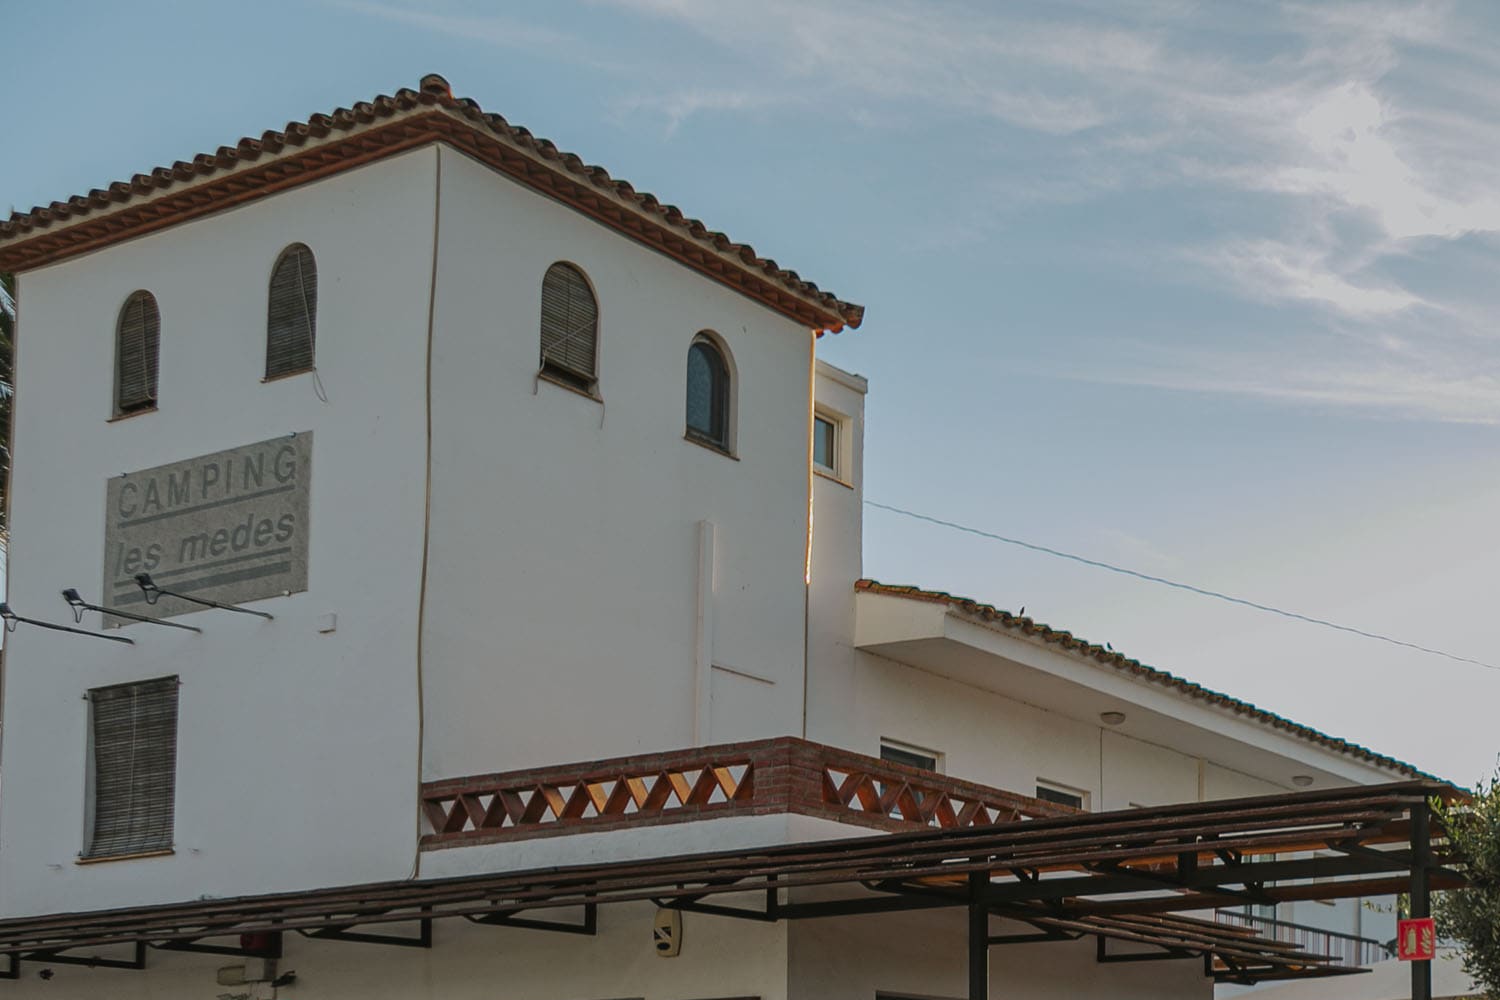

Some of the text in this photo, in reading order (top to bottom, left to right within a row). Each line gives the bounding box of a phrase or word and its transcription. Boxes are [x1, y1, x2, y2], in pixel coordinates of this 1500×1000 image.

[118, 445, 297, 519] CAMPING
[114, 513, 296, 577] les medes
